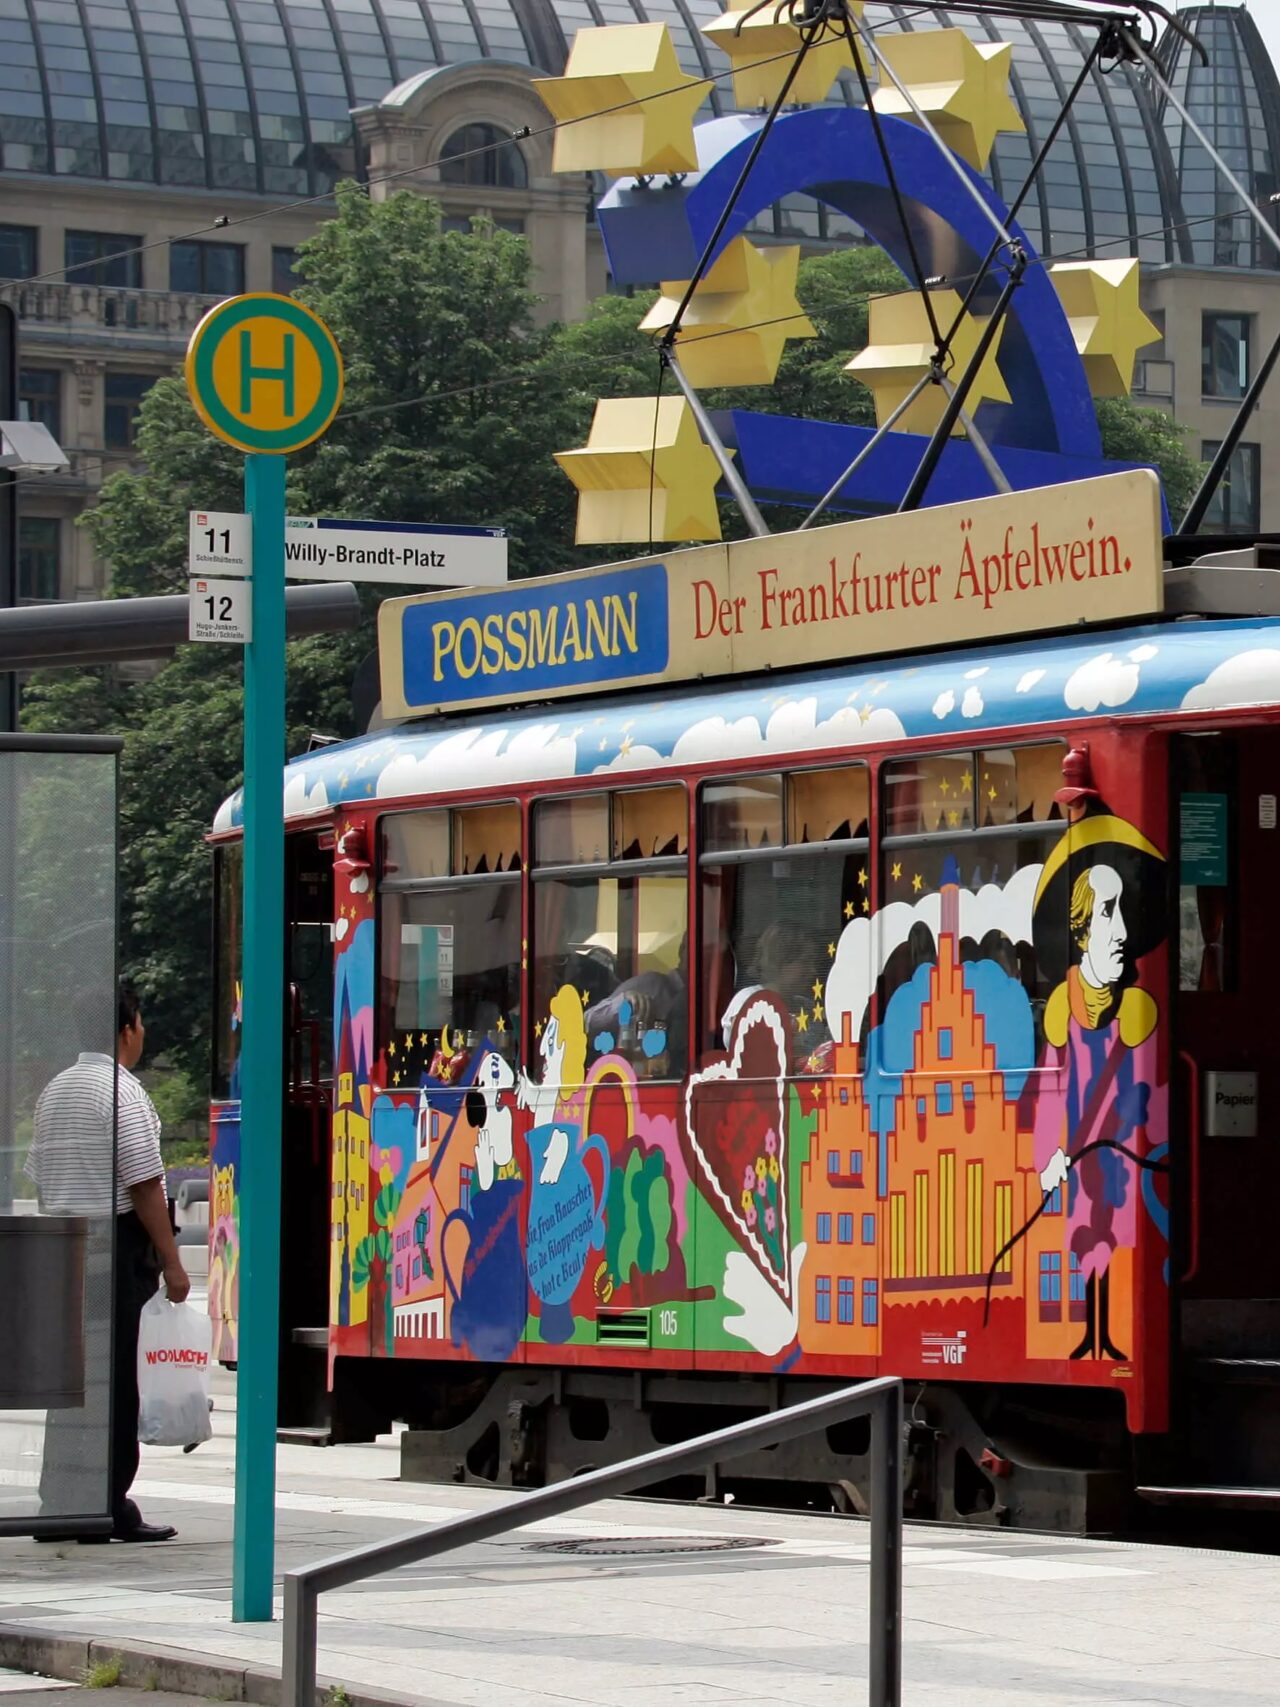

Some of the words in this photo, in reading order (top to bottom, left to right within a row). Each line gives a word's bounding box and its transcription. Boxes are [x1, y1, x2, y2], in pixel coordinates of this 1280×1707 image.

[240, 330, 294, 416] H
[205, 528, 230, 553] 11
[285, 542, 446, 568] Willy-Brandt-Platz
[692, 580, 747, 640] Der
[758, 552, 942, 631] Frankfurter
[954, 517, 1132, 611] Äpfelwein.
[205, 596, 232, 621] 12
[431, 591, 639, 682] POSSMANN
[1216, 1091, 1256, 1109] Papier
[659, 1310, 678, 1335] 105
[943, 1331, 967, 1364] VGF
